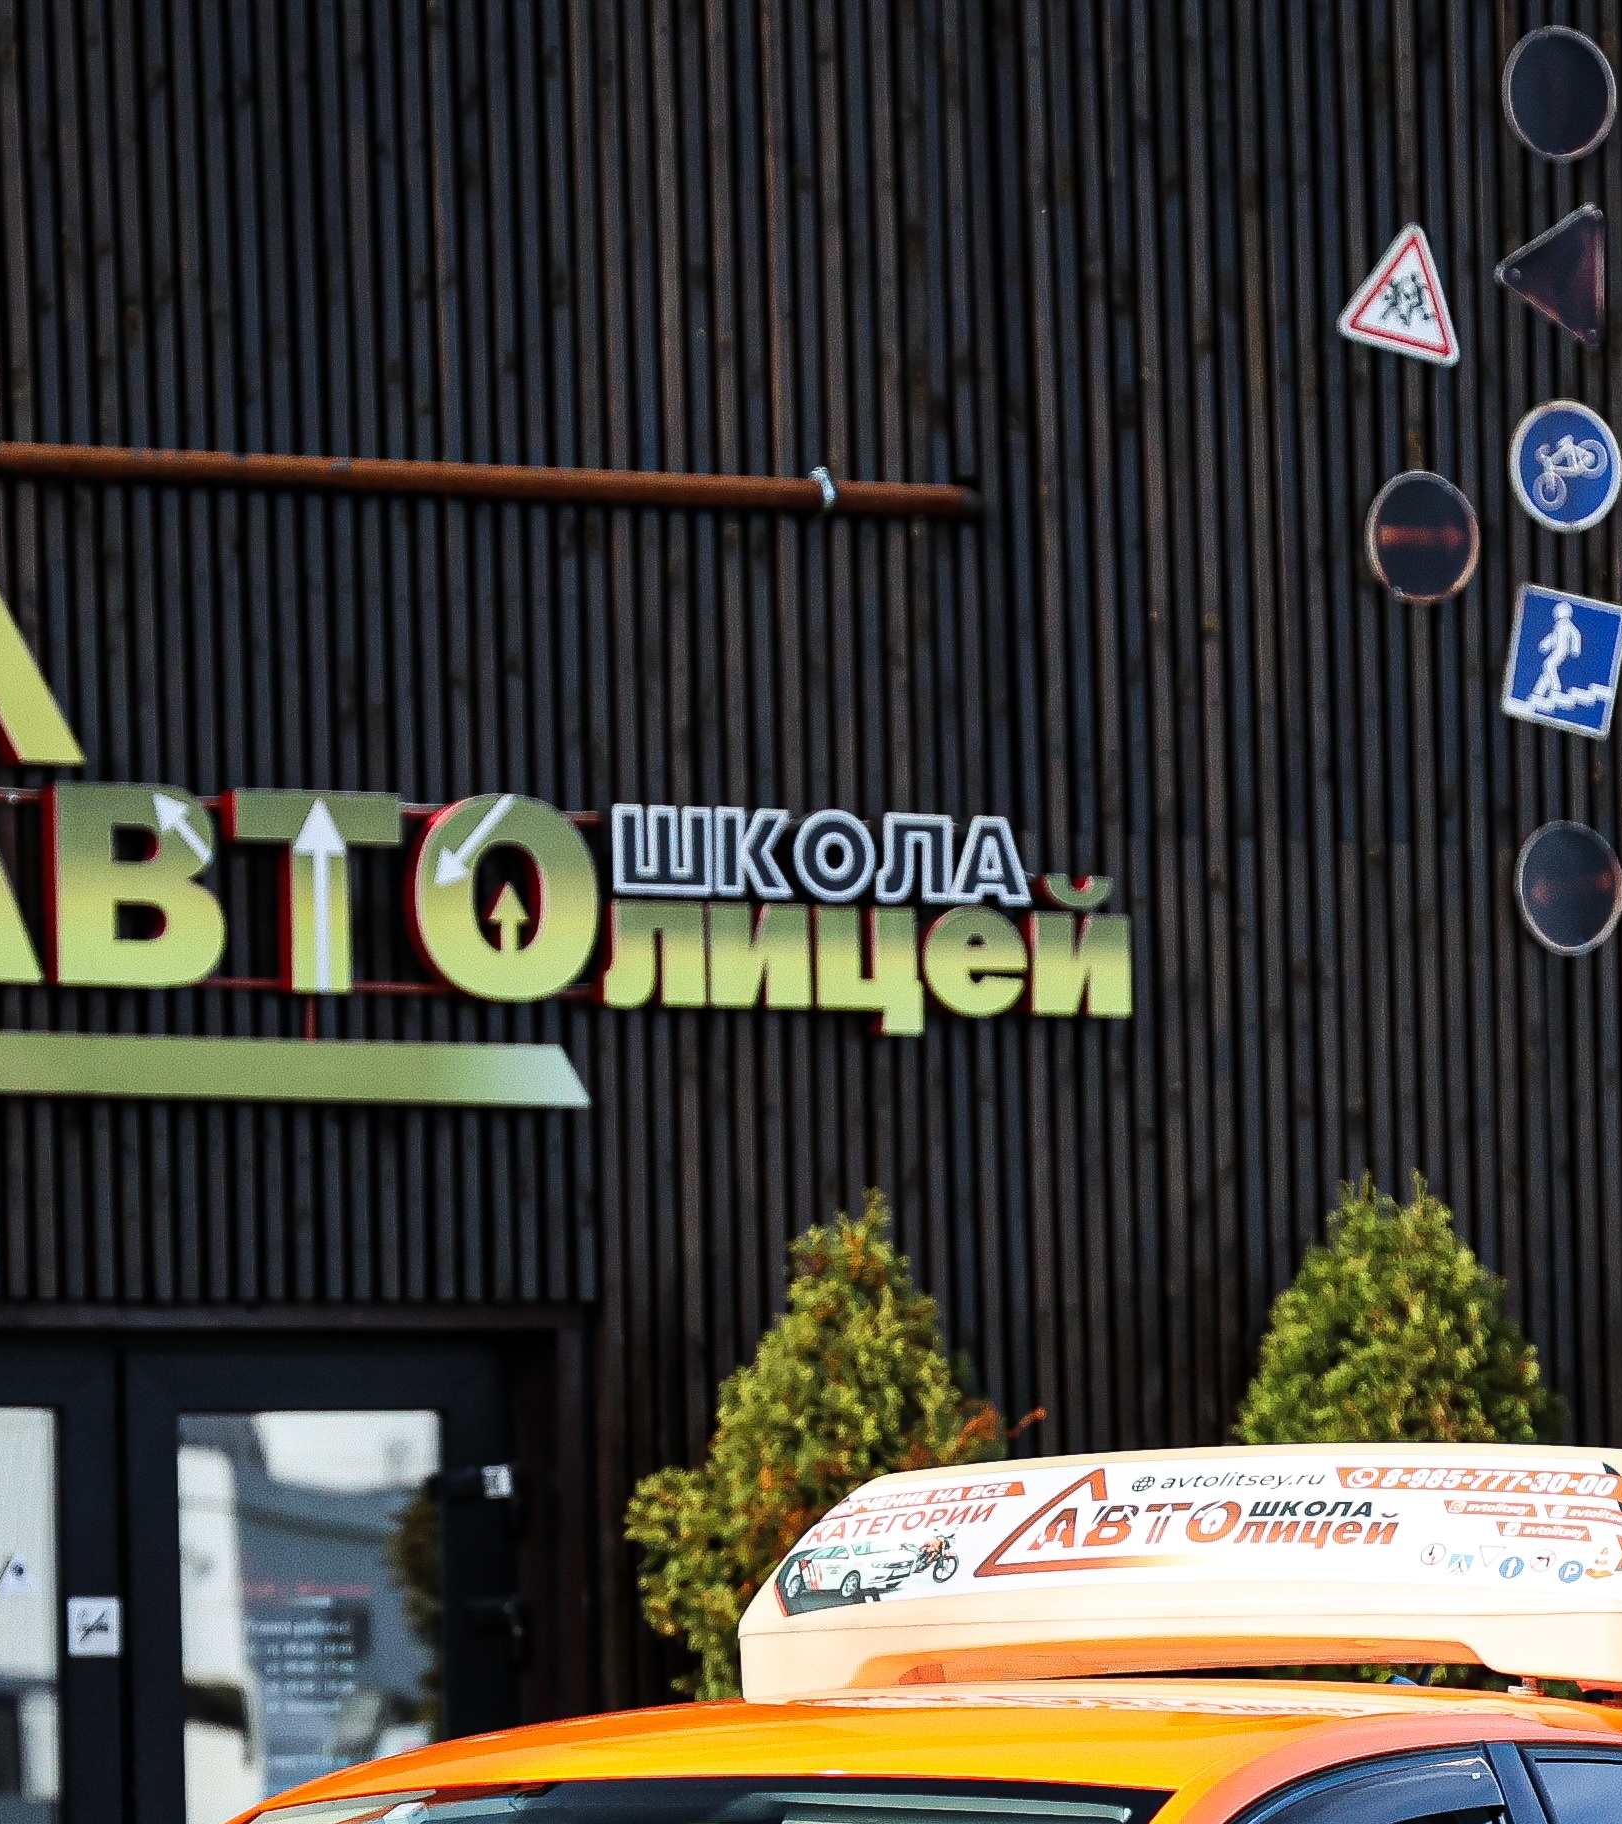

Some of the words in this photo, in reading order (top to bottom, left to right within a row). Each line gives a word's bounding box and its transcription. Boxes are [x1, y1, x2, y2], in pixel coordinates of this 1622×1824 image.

[611, 803, 1032, 905] ШКОЛА
[603, 873, 1133, 1037] лицей
[966, 1482, 1012, 1499] ВСЕ
[1160, 1470, 1326, 1490] avtolitsey.ru
[806, 1502, 998, 1546] КАТЕГОРИИ
[1028, 1500, 1243, 1550] АВТО
[1248, 1500, 1373, 1518] ШКОЛА
[1233, 1512, 1400, 1550] лицей
